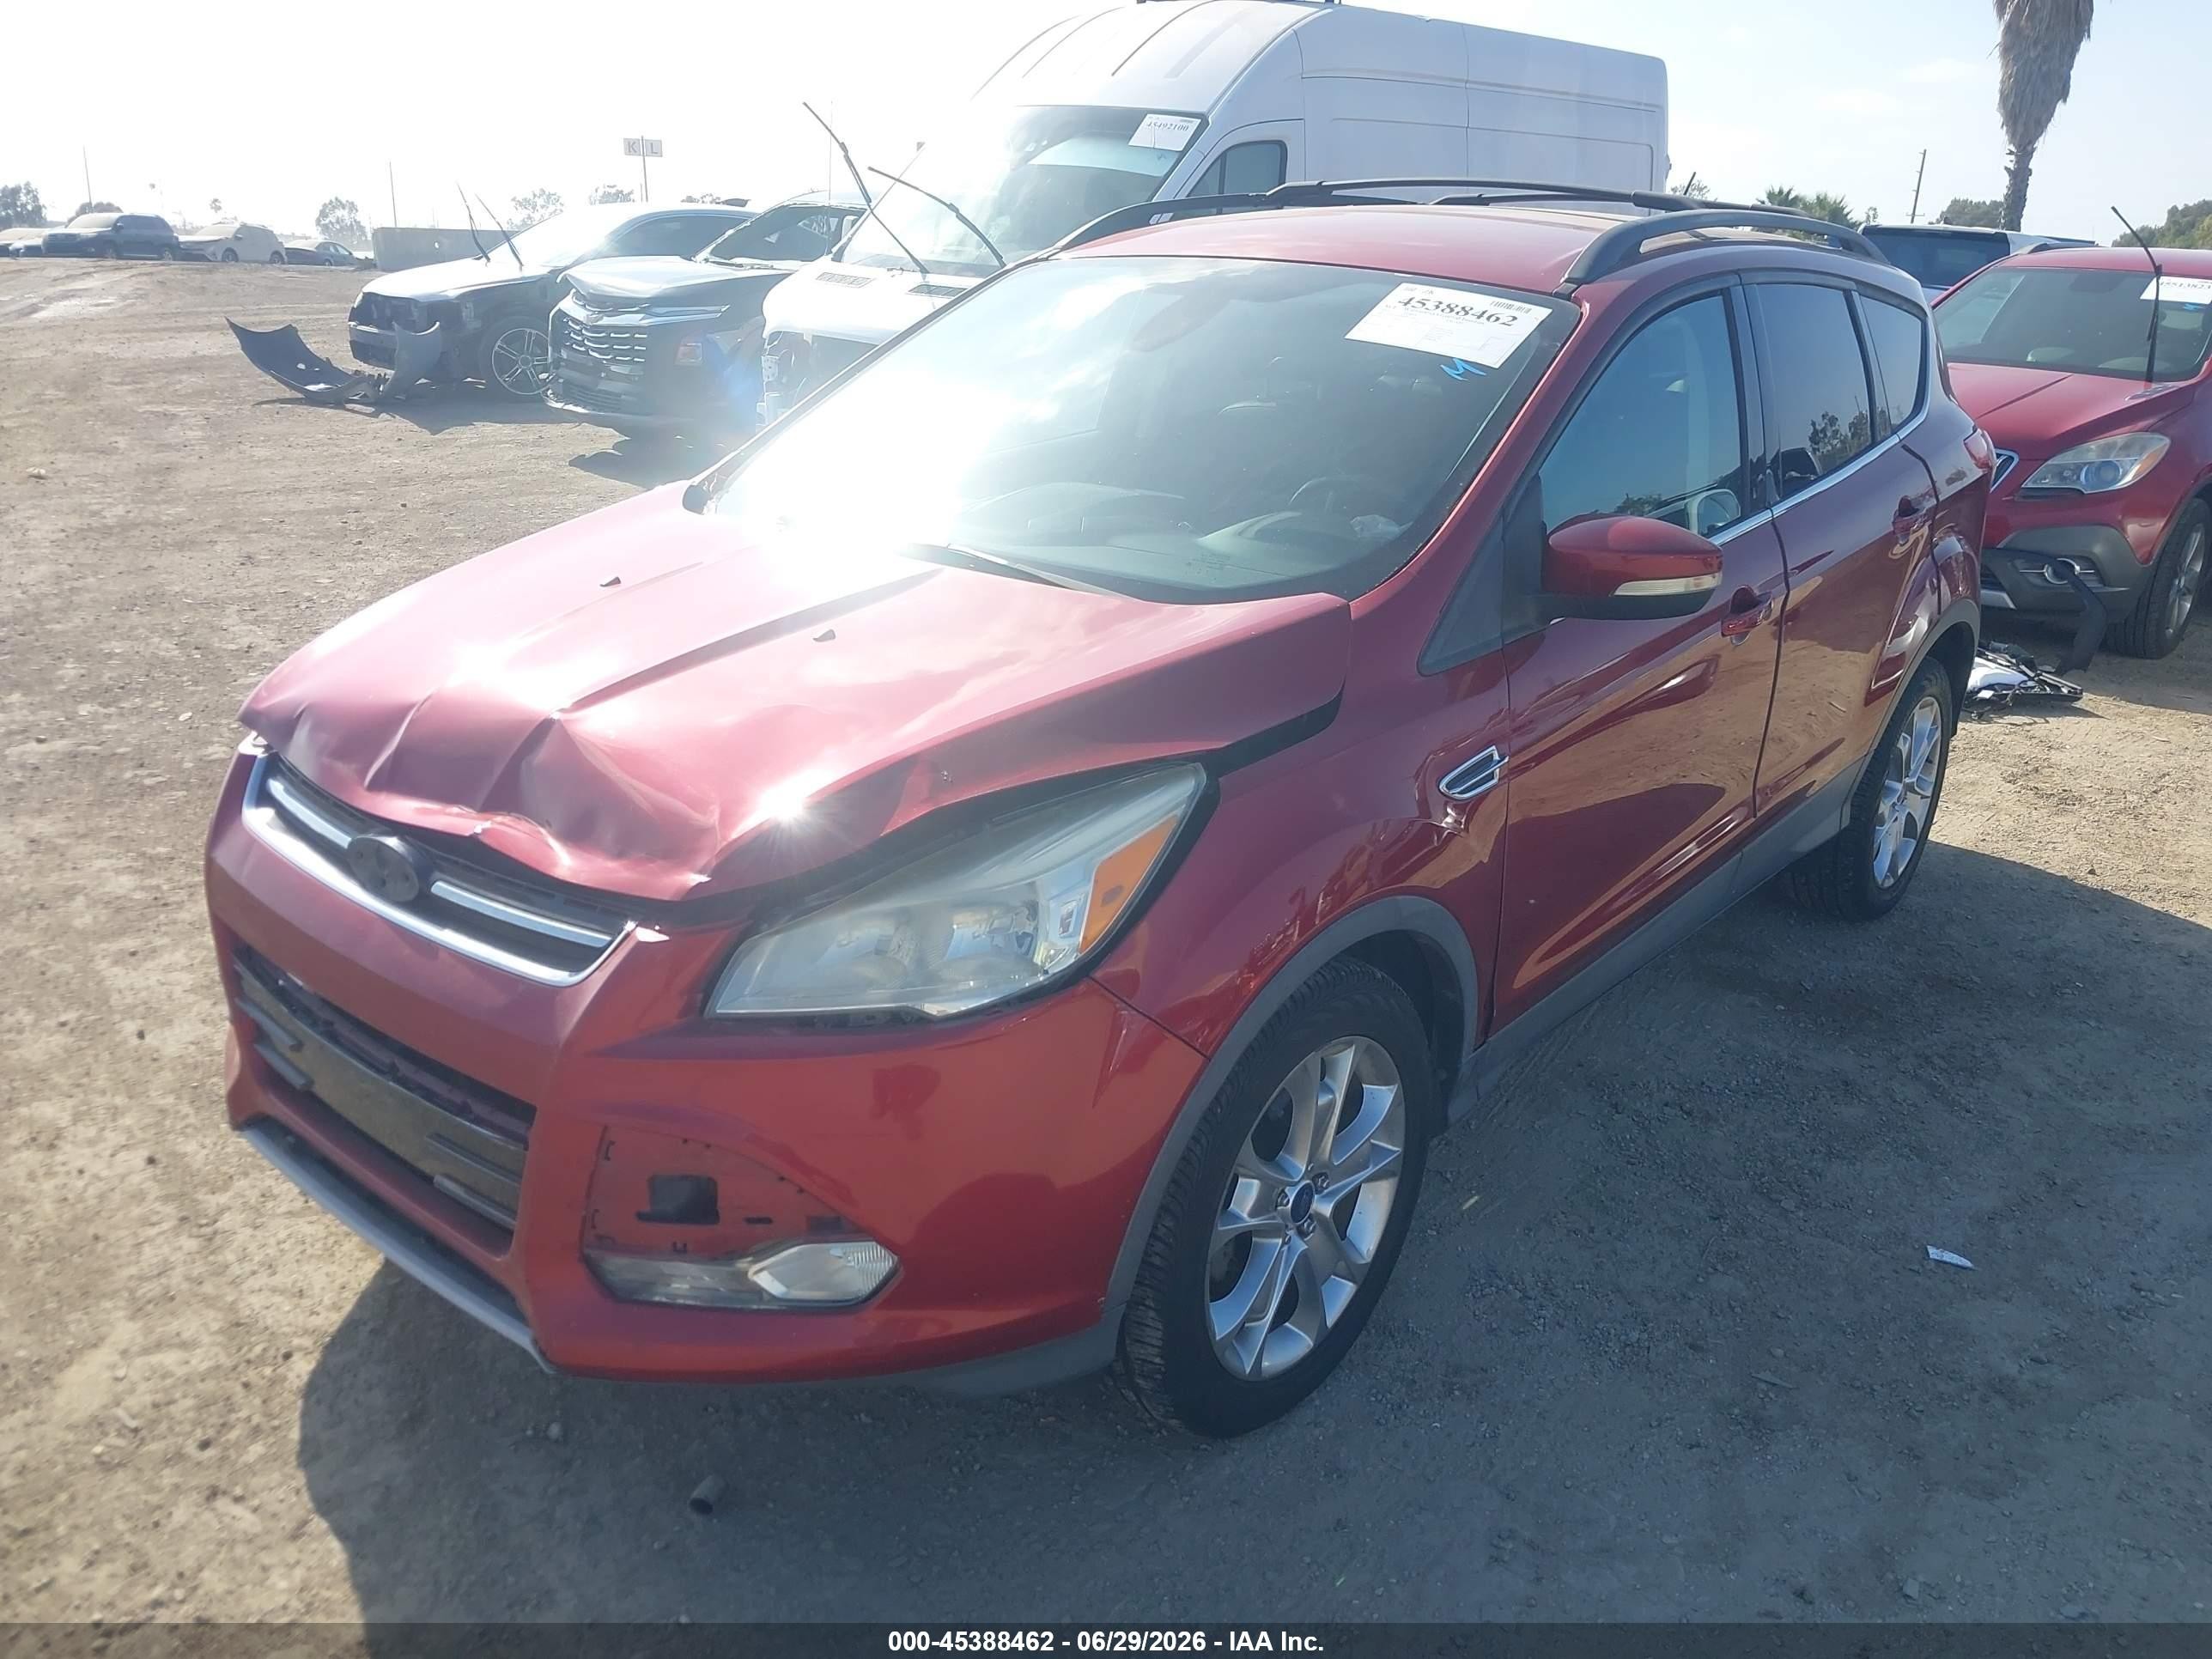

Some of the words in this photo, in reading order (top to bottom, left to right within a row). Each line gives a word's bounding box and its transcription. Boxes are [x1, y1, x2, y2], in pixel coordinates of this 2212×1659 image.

[628, 141, 637, 154] K
[650, 142, 659, 155] L
[1398, 296, 1518, 327] 45388462
